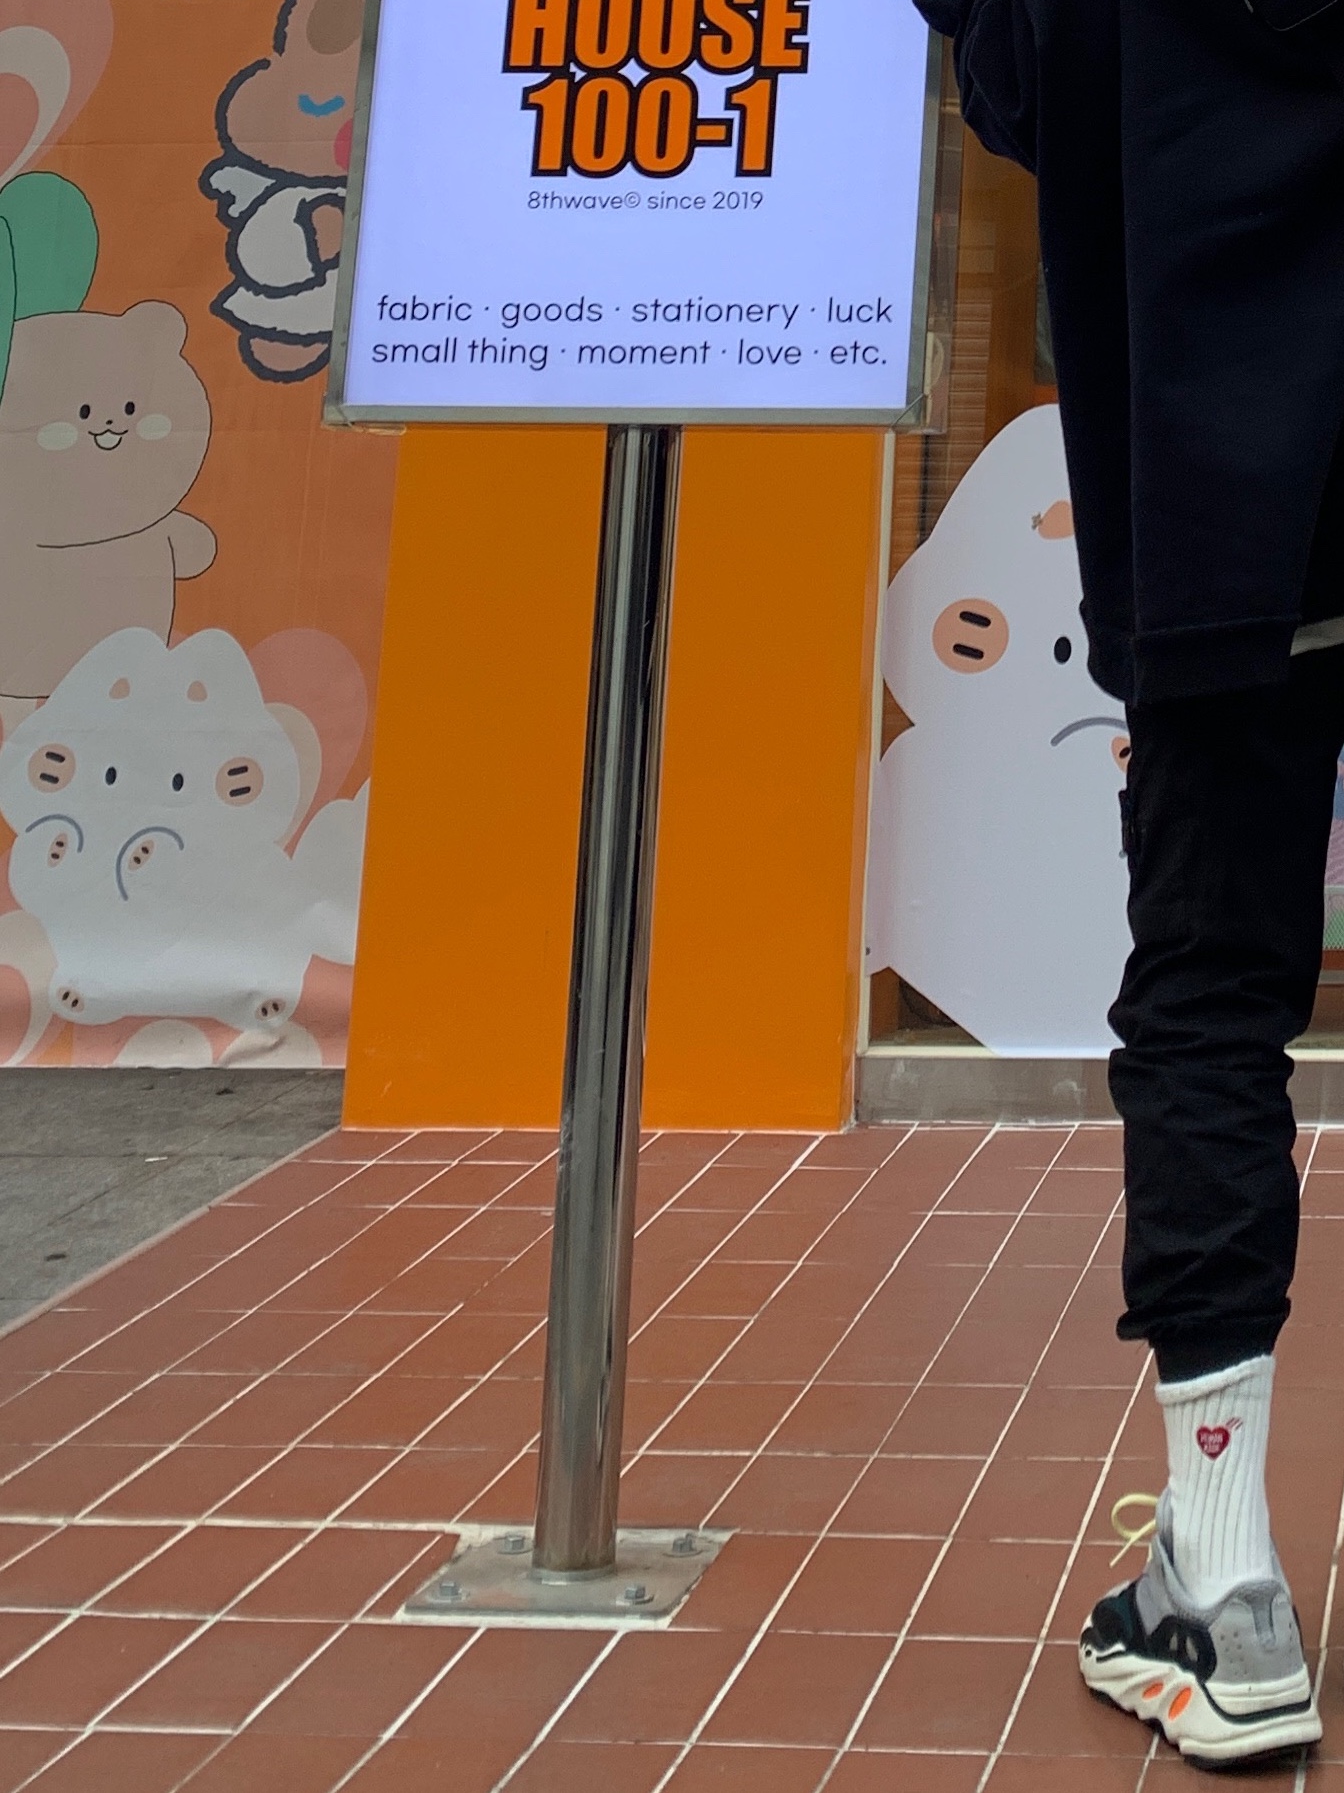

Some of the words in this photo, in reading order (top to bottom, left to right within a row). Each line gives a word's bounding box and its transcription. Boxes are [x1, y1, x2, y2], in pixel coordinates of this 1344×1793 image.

[521, 71, 779, 179] 100-1
[646, 189, 706, 210] since
[712, 189, 764, 210] 2019
[377, 294, 473, 324] fabric
[500, 294, 603, 330] goods
[631, 296, 799, 331] stationery
[826, 294, 893, 324] luck
[371, 337, 460, 365] small
[467, 337, 548, 371] thing
[577, 340, 711, 365] moment
[737, 338, 802, 366] love
[829, 340, 888, 366] etc.
